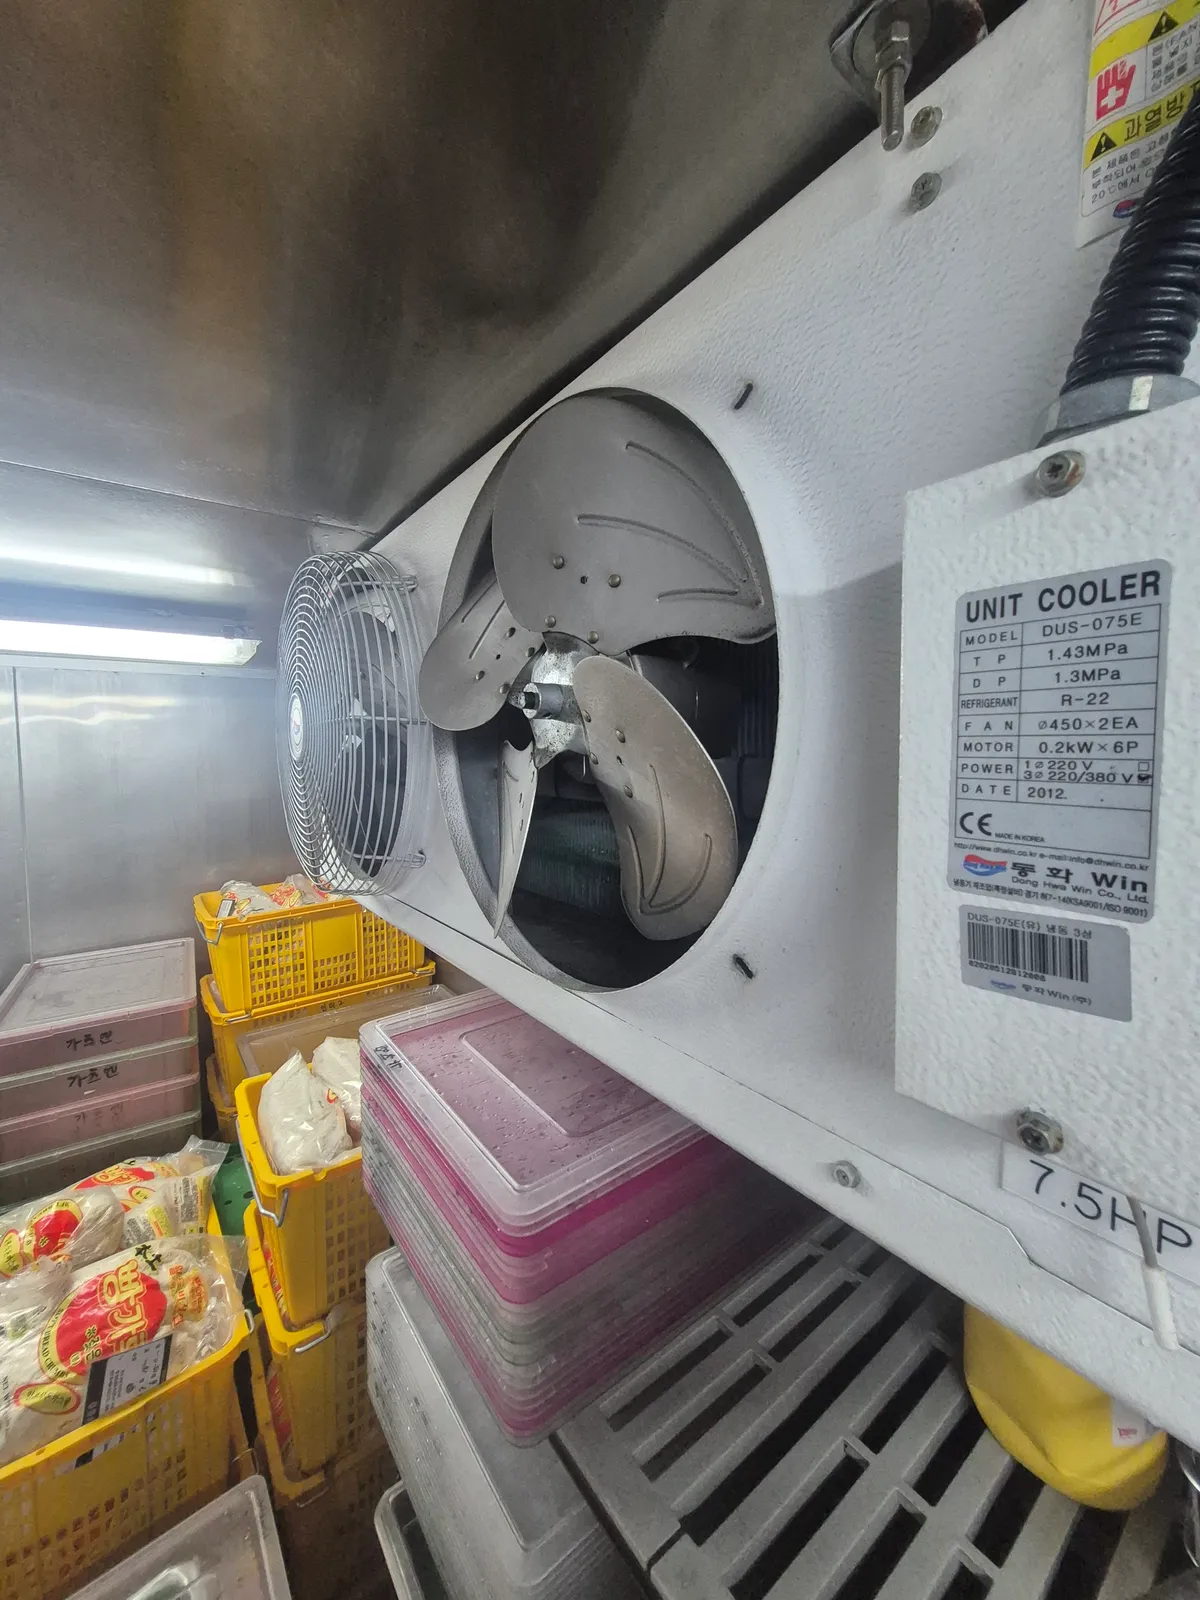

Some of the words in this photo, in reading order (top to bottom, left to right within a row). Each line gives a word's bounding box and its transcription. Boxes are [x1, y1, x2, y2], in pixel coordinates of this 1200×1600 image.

[966, 592, 1023, 624] UNIT
[1037, 569, 1161, 613] COOLER
[965, 630, 1019, 646] MODEL
[1042, 612, 1143, 637] DUS-075E
[1047, 641, 1129, 661] 1.43MPa
[1055, 667, 1121, 684] 1.3MPa
[960, 696, 1019, 709] REFRIGERANT
[1061, 691, 1111, 707] R-22
[963, 742, 1014, 752] MOTOR
[961, 763, 1014, 774] POWER
[961, 783, 1012, 796] DATE
[1011, 875, 1040, 888] Dong
[1042, 880, 1068, 892] Hwa
[1071, 884, 1093, 896] Win
[1090, 871, 1149, 894] Win
[1029, 1158, 1194, 1255] 7.5HP
